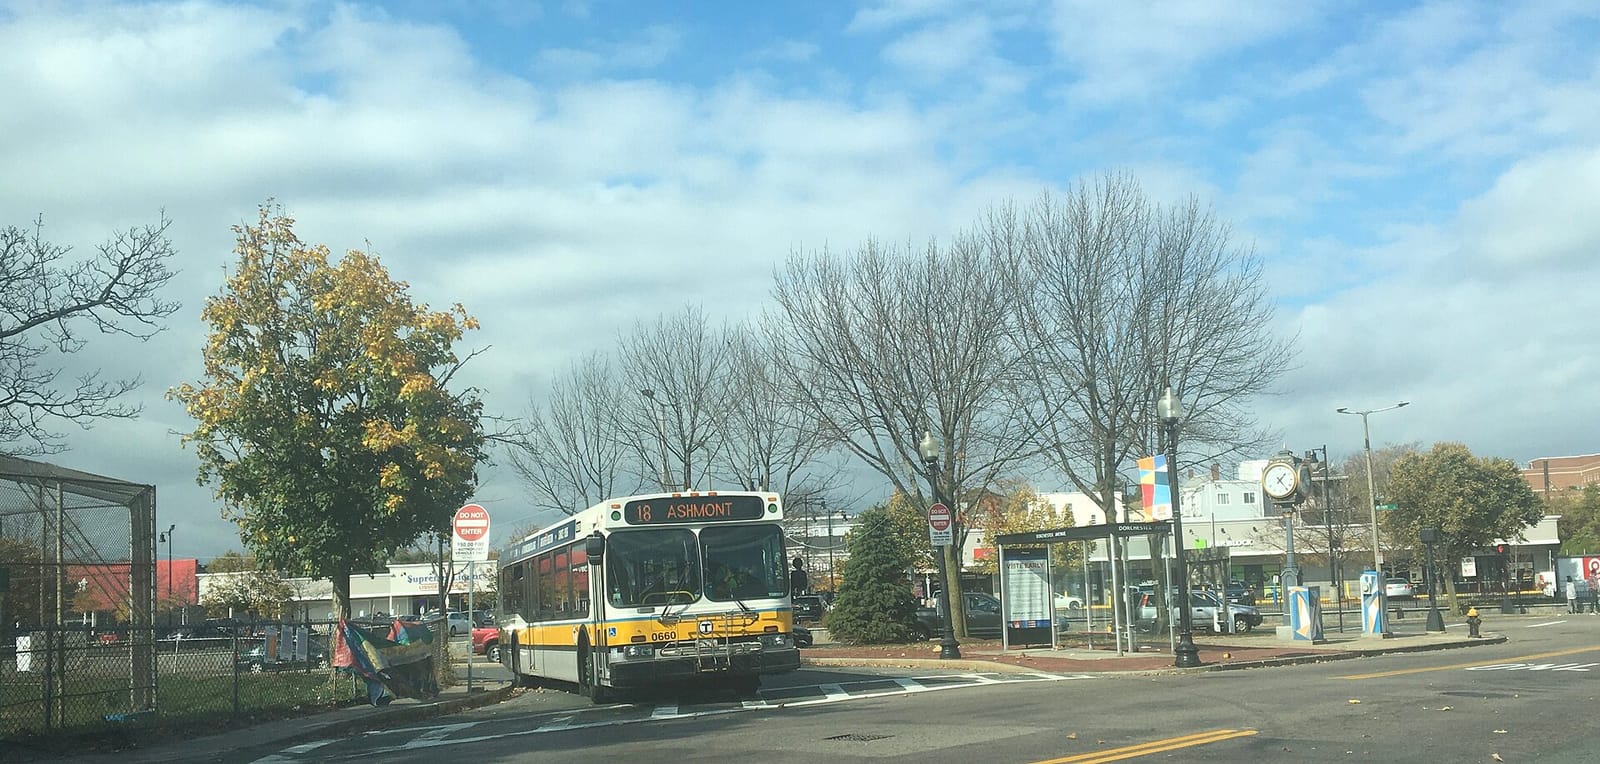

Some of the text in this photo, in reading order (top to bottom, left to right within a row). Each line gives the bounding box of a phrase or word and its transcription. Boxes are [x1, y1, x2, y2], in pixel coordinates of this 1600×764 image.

[636, 502, 733, 522] 18 ASHMONT
[651, 631, 677, 642] 0660
